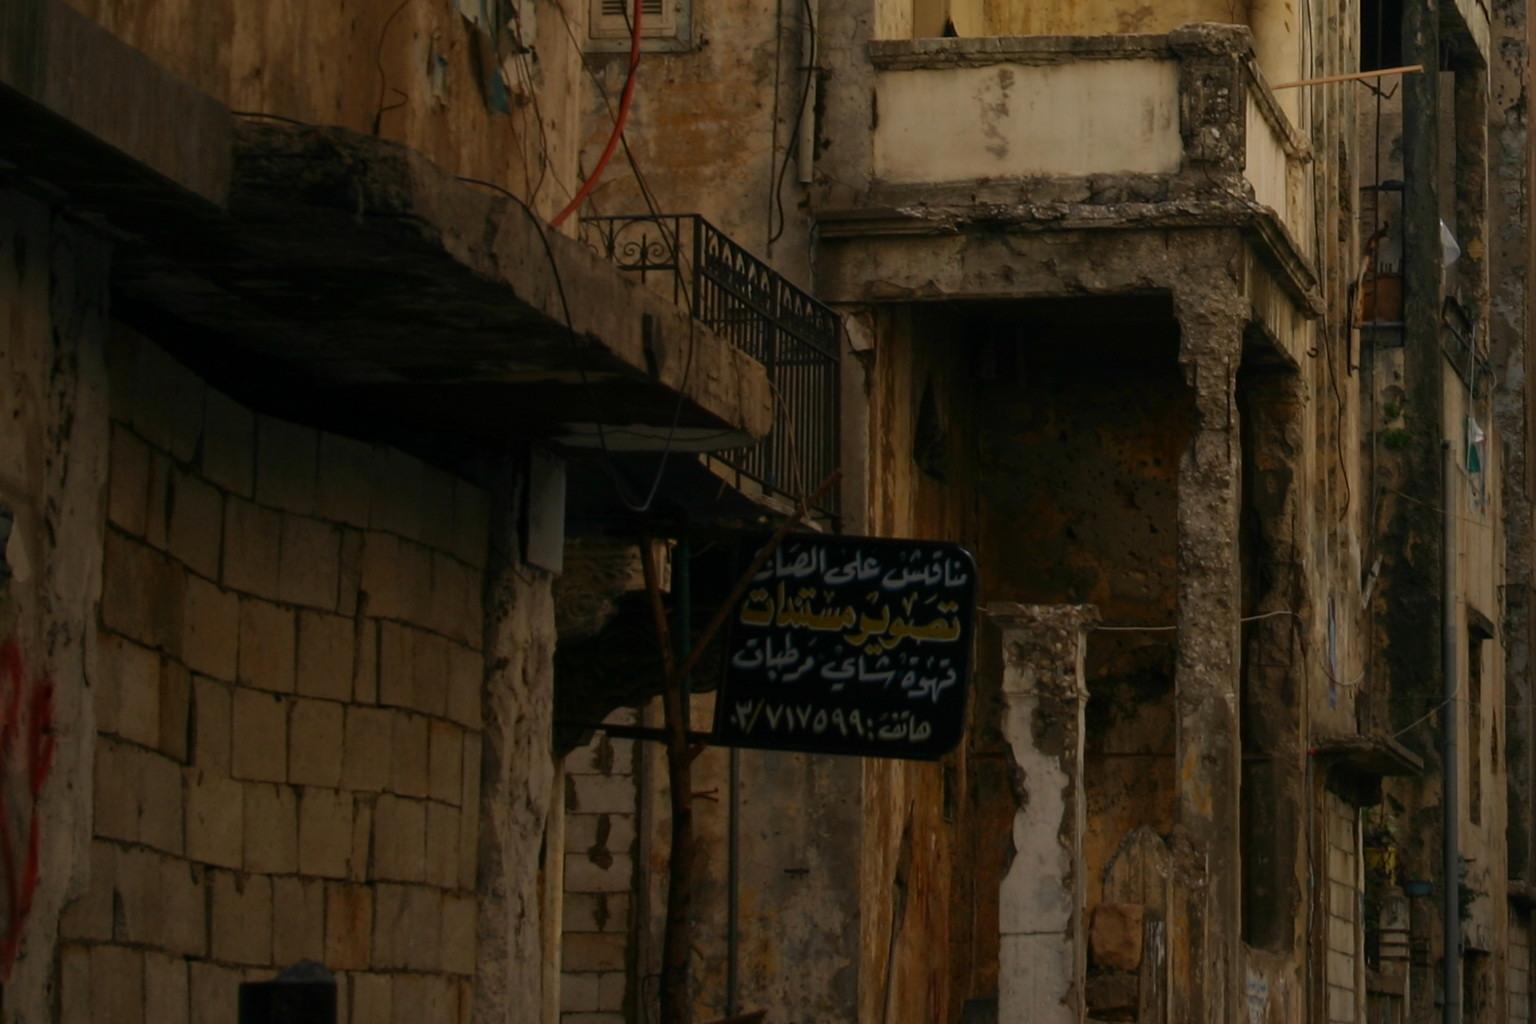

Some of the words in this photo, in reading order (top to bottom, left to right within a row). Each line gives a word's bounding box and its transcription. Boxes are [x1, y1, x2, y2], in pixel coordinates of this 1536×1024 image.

[823, 549, 881, 584] على
[740, 580, 856, 631] مستندات
[843, 591, 961, 655] تصوير
[731, 632, 816, 682] مرطبات
[820, 645, 896, 692] شاي
[901, 654, 957, 704] قهوة
